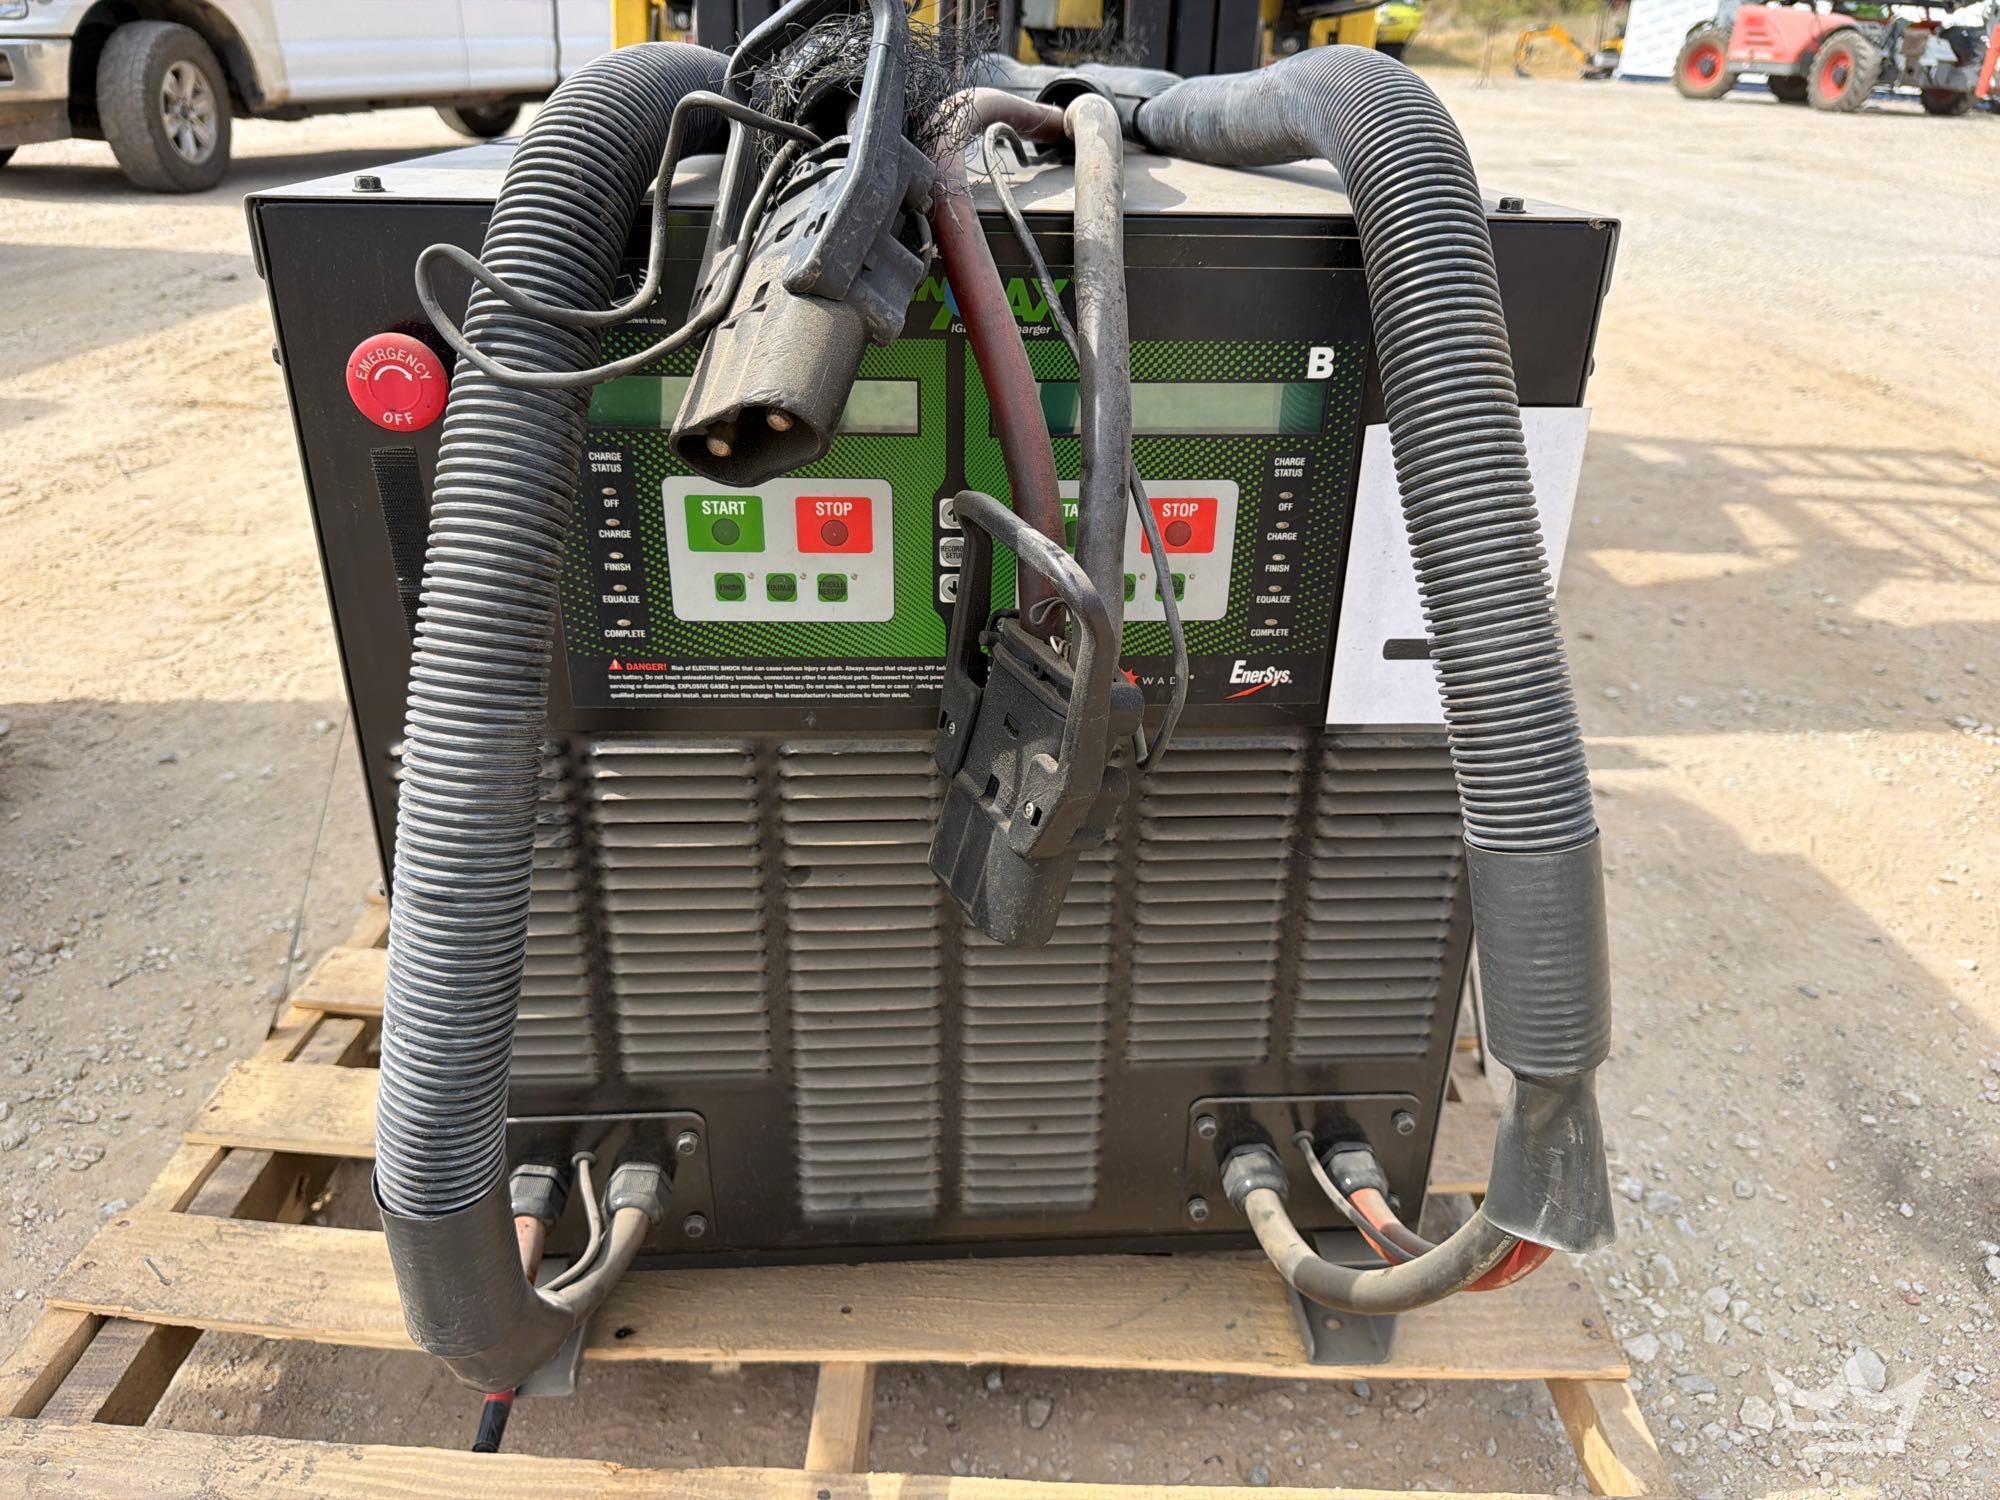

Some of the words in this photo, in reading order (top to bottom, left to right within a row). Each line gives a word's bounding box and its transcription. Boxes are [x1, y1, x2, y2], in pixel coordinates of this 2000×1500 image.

[355, 346, 432, 381] EMERGENCY
[1307, 346, 1335, 379] B
[383, 412, 414, 426] OFF
[588, 452, 622, 462] CHARGE
[1274, 457, 1306, 466] CHARGE
[591, 464, 622, 473] STATUS
[1274, 468, 1303, 478] STATUS
[604, 500, 620, 508] OFF
[702, 500, 746, 516] START
[816, 501, 853, 516] STOP
[1278, 502, 1294, 512] OFF
[1162, 502, 1199, 518] STOP
[598, 530, 632, 538] CHARGE
[1266, 532, 1298, 541] CHARGE
[604, 562, 632, 572] FINISH
[1264, 564, 1290, 572] FINISH
[602, 594, 640, 604] EQUALIZE
[1256, 595, 1292, 604] EQUALIZE
[604, 630, 646, 638] COMPLETE
[1250, 628, 1290, 637] COMPLETE
[626, 662, 667, 671] DANGER!
